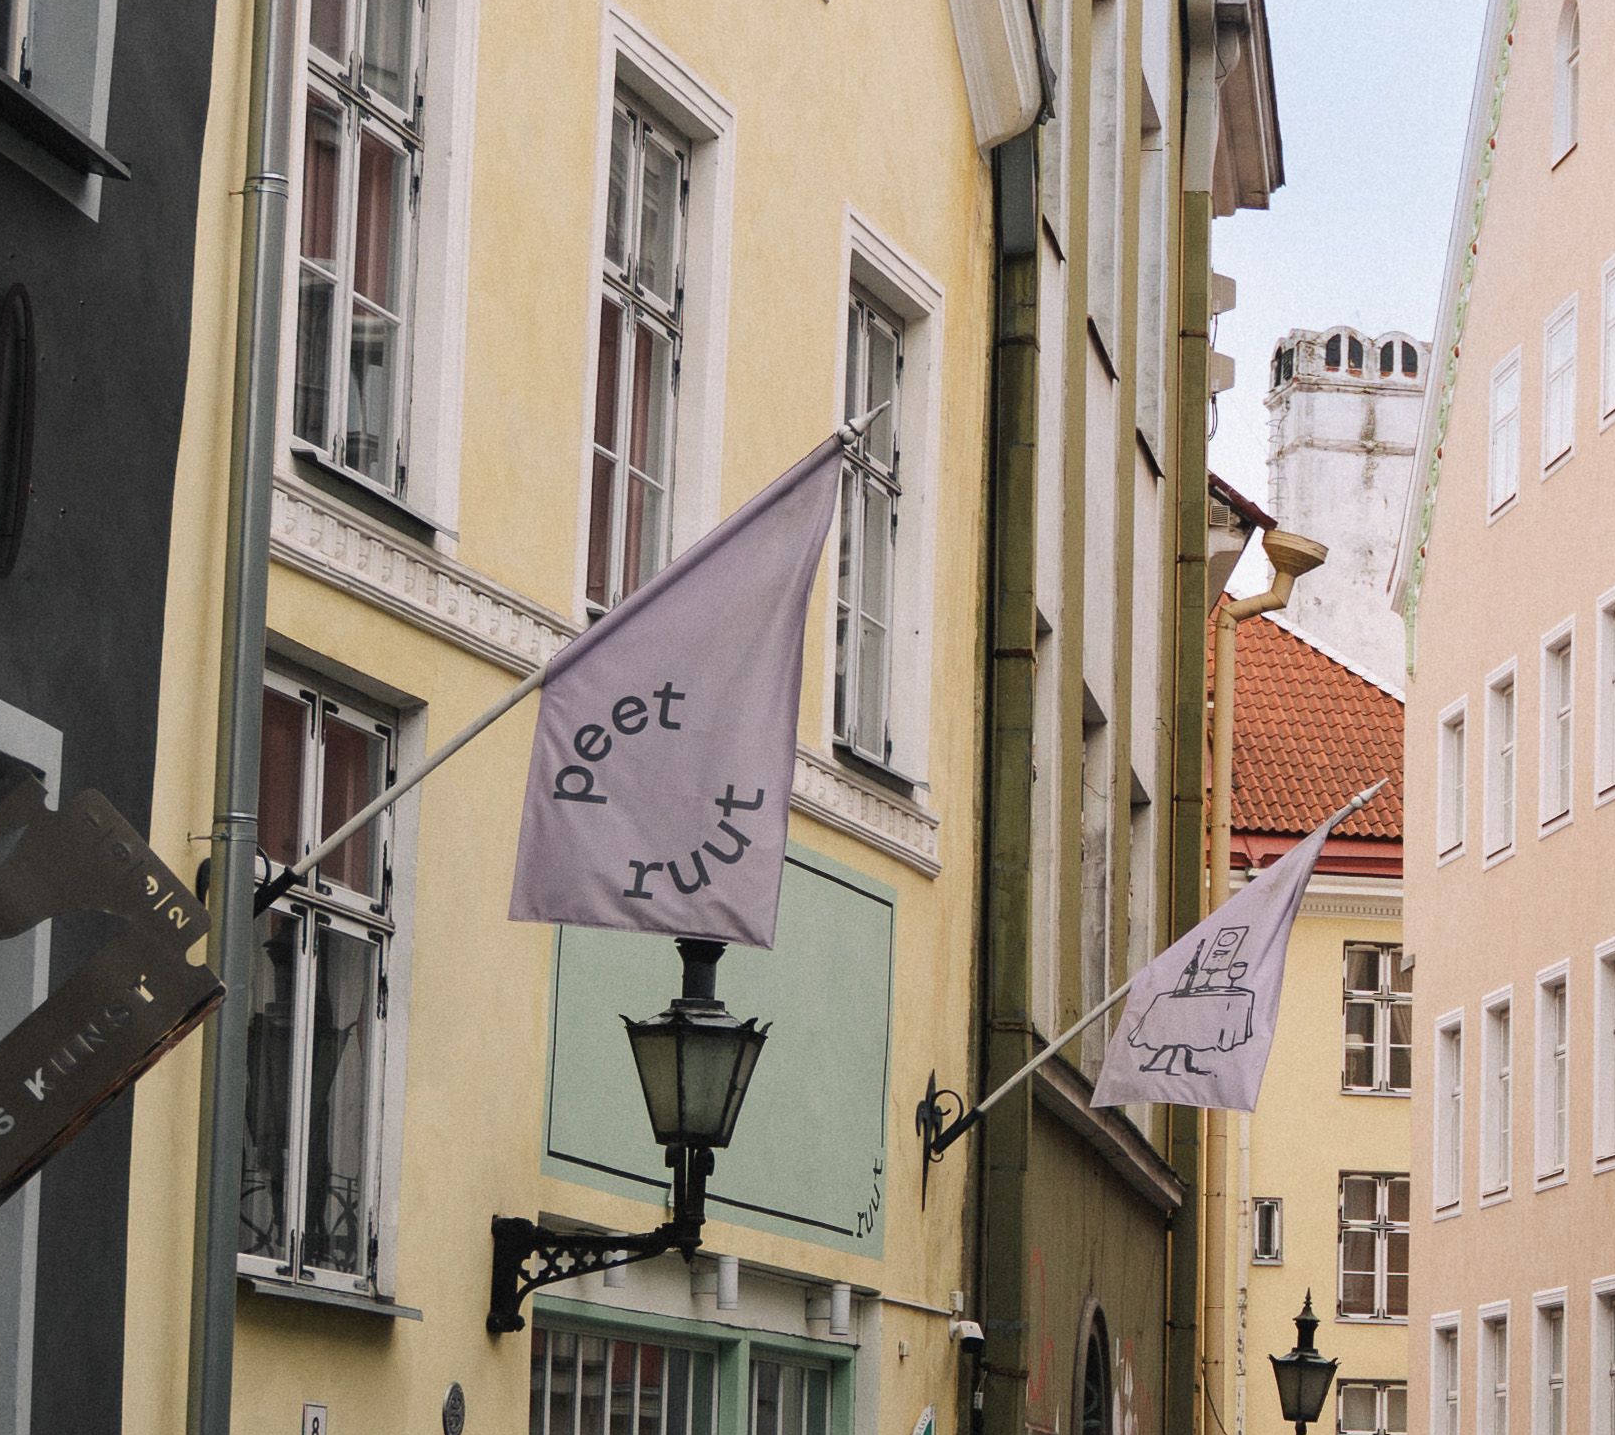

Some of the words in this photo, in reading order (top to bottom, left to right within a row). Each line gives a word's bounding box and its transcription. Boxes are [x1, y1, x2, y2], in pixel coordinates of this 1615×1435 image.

[553, 681, 686, 804] peet
[623, 783, 766, 901] ruut
[23, 975, 156, 1103] KUNST
[857, 1157, 884, 1239] ruut
